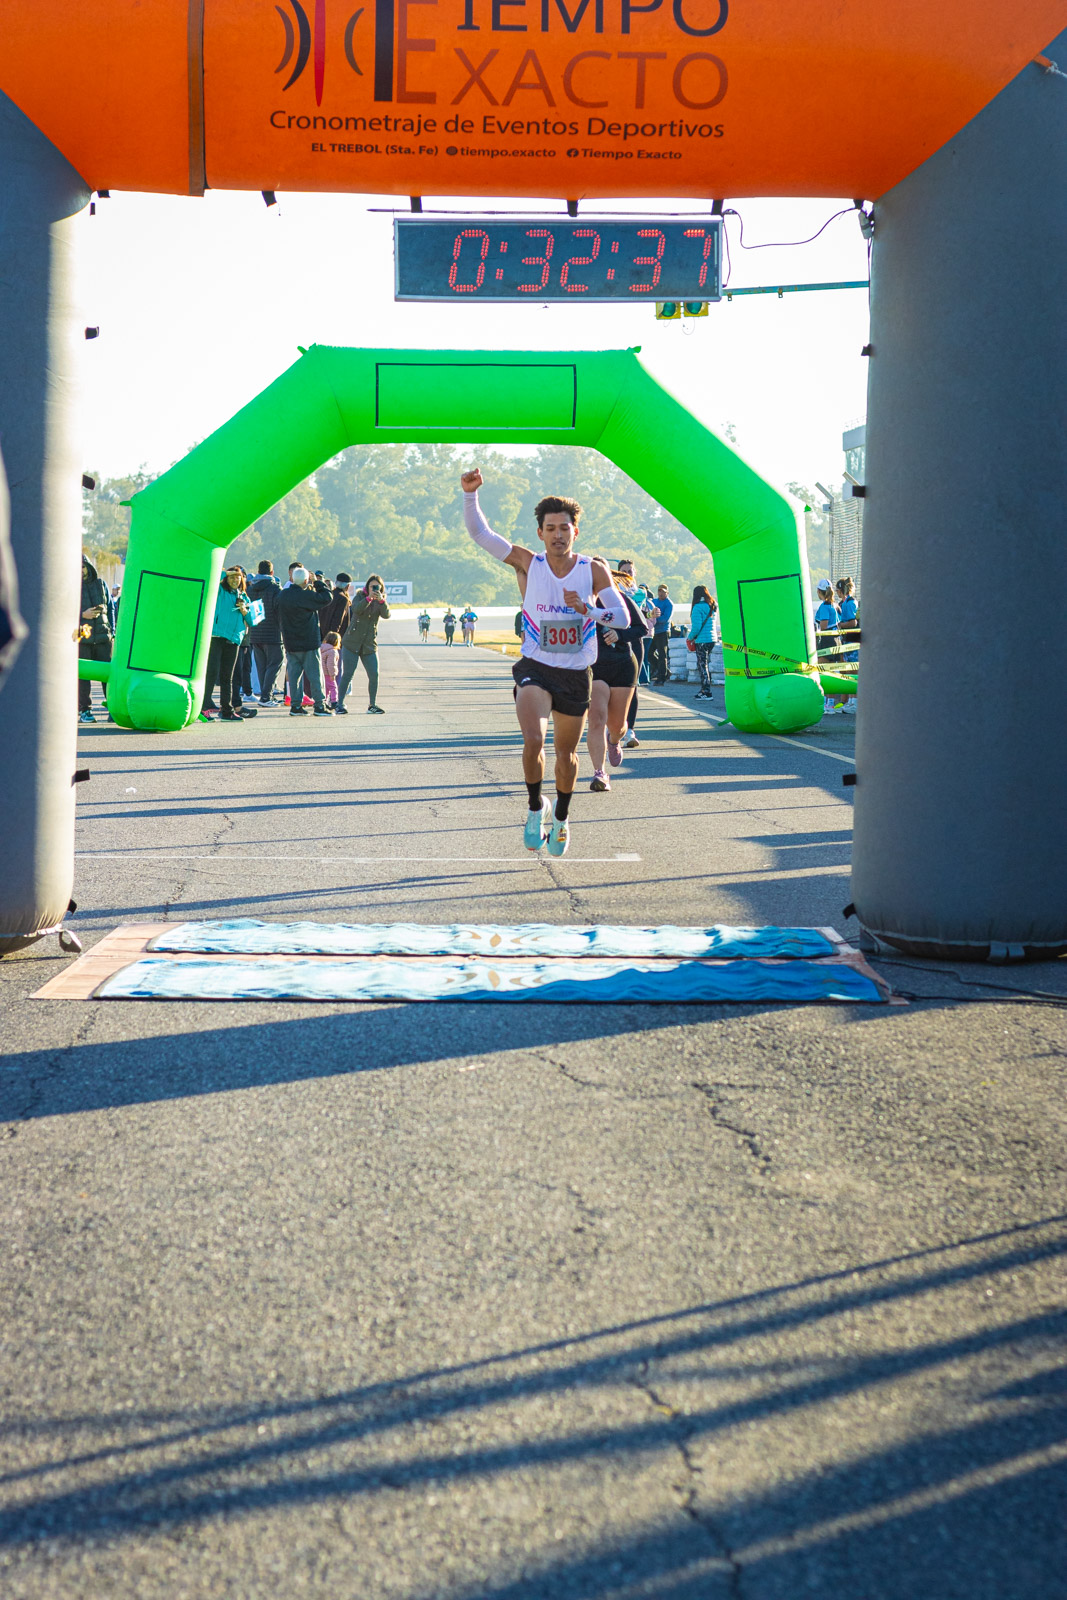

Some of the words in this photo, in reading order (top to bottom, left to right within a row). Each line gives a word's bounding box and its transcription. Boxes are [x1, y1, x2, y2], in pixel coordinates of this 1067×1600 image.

[269, 110, 437, 137] Cronometraje
[444, 114, 475, 134] de
[482, 115, 579, 136] Eventos
[587, 117, 725, 141] Deportivos
[311, 143, 327, 152] EL
[329, 143, 382, 154] TREBOL
[385, 144, 416, 155] (Sta.
[419, 145, 439, 156] Fe)
[460, 146, 556, 159] tiempo.exacto
[581, 148, 633, 160] Tiempo
[637, 150, 682, 160] Exacto
[536, 603, 577, 615] RUNNE
[549, 627, 577, 645] 303
